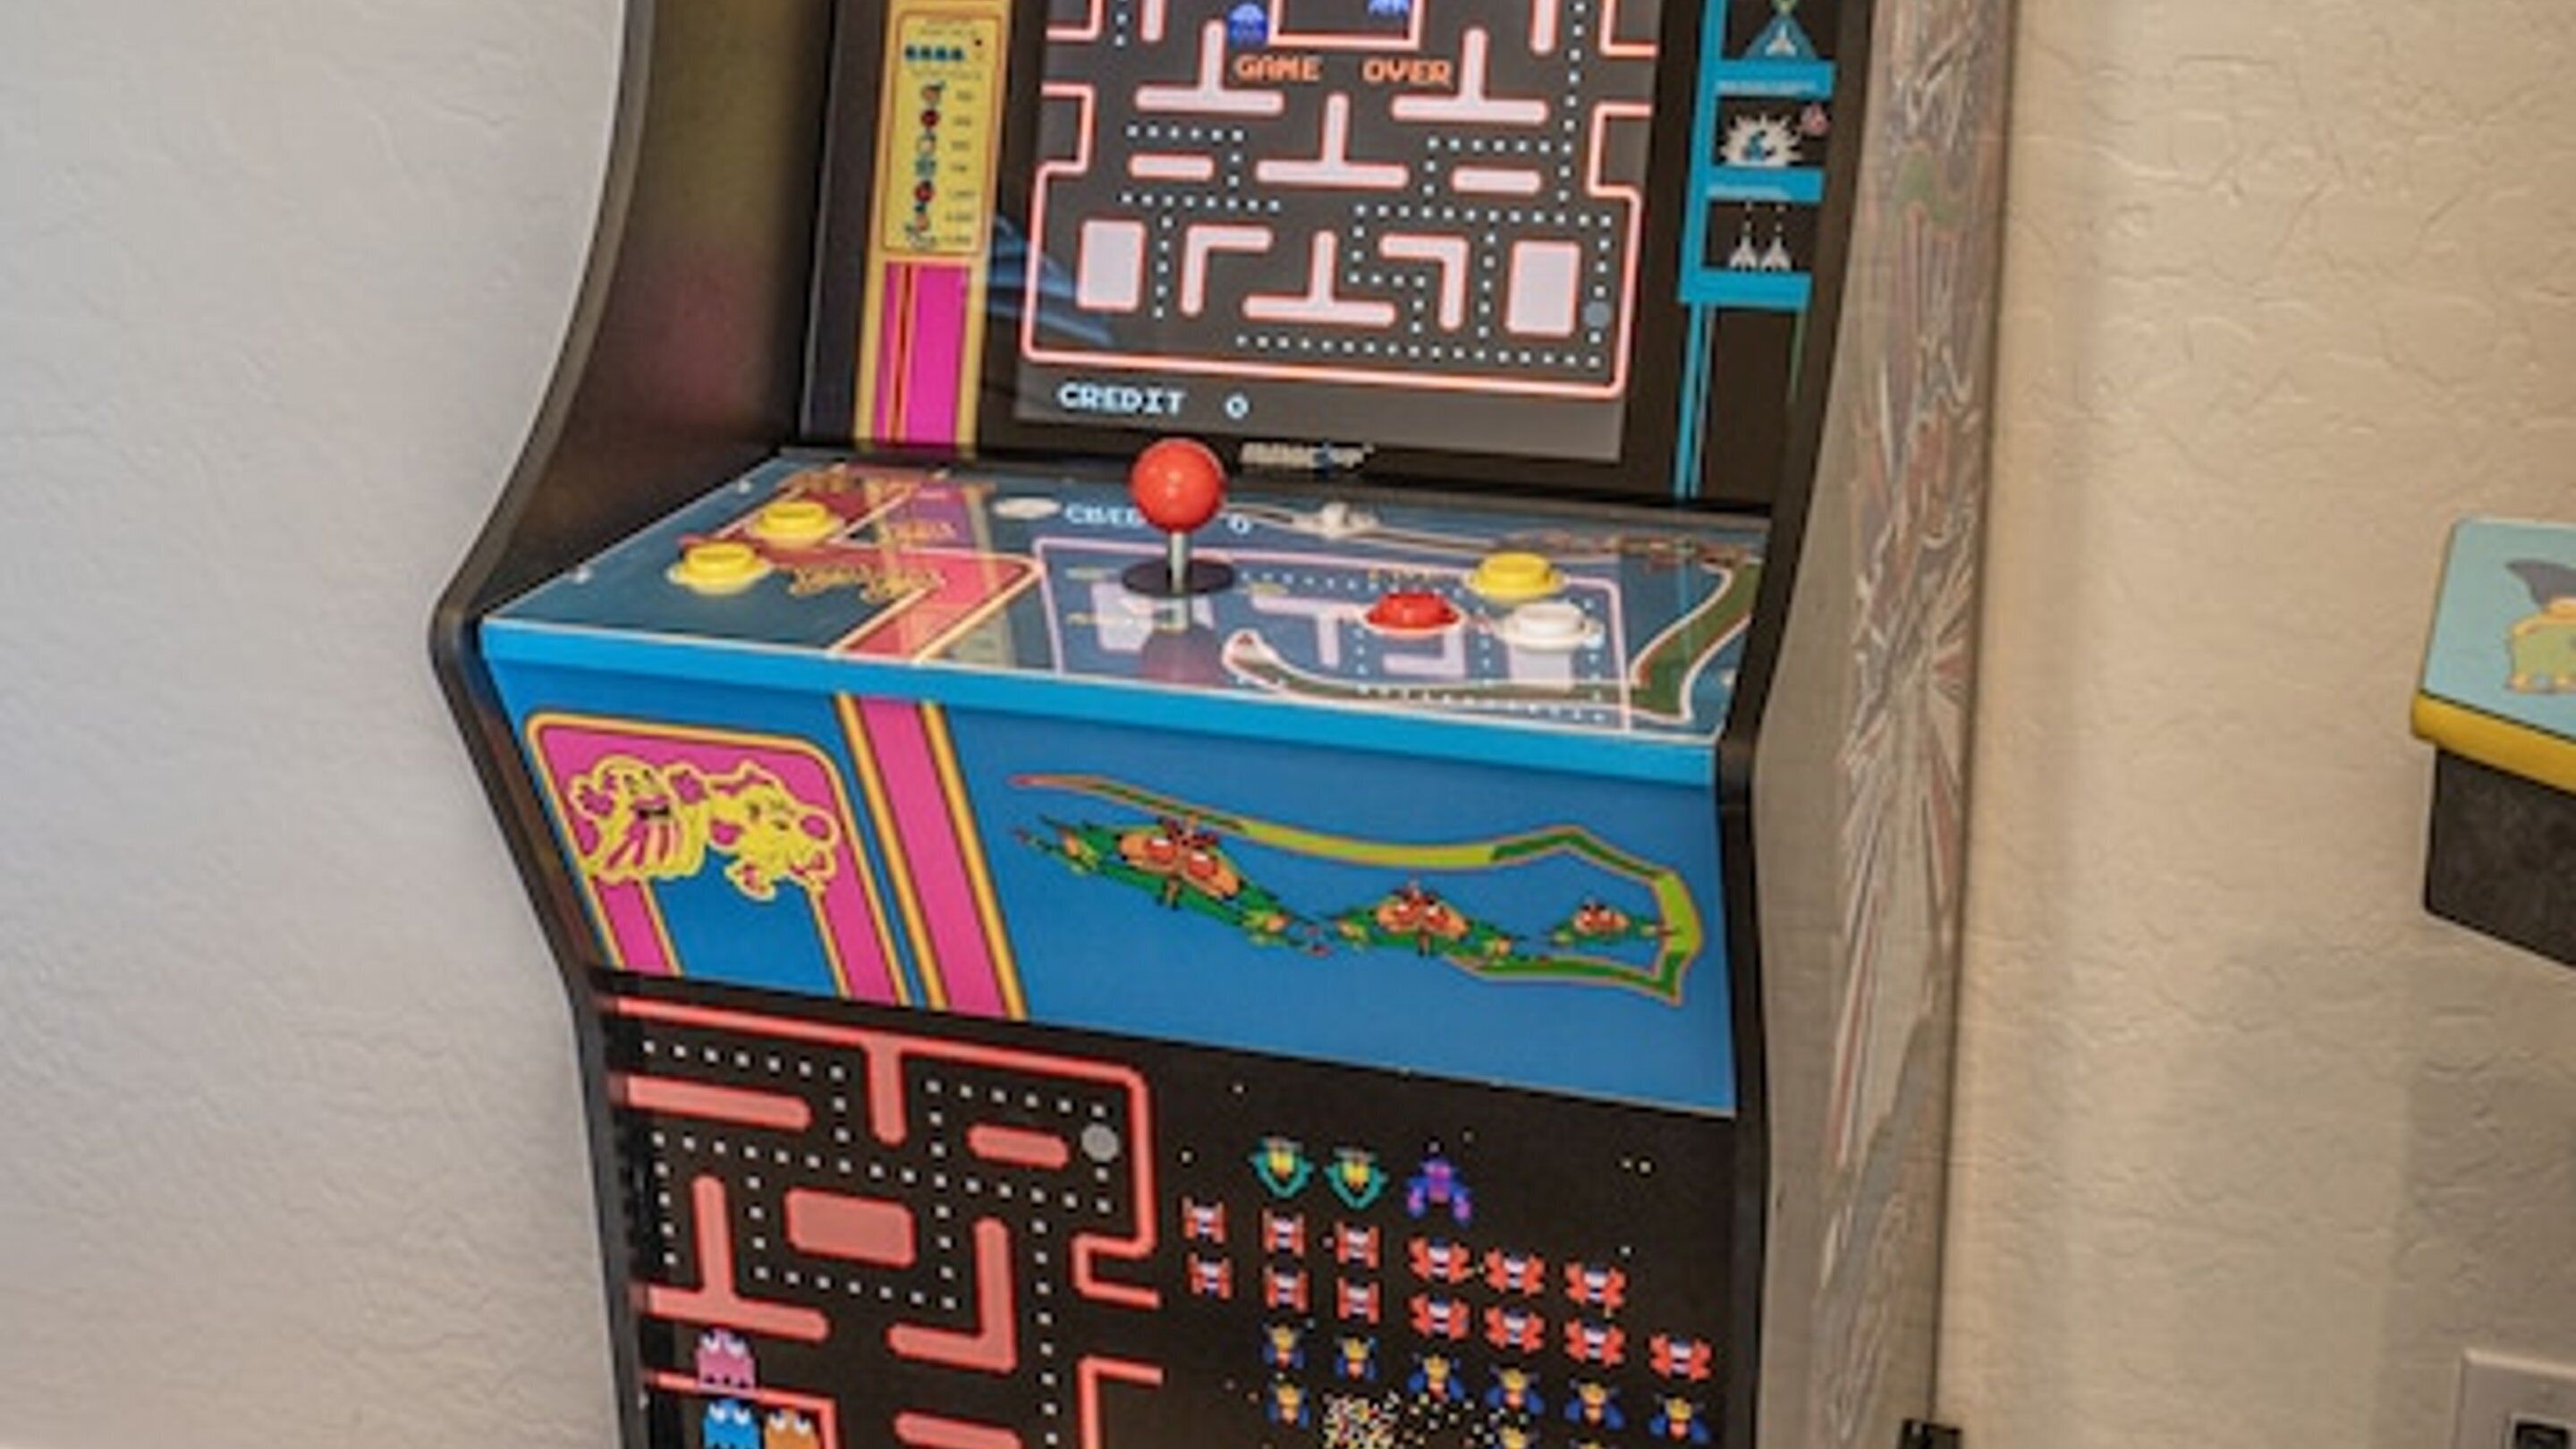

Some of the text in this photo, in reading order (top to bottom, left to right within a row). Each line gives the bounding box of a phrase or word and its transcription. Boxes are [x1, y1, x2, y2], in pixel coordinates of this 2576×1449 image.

[1234, 55, 1454, 87] GAME OVER
[1058, 382, 1186, 416] CREDIT
